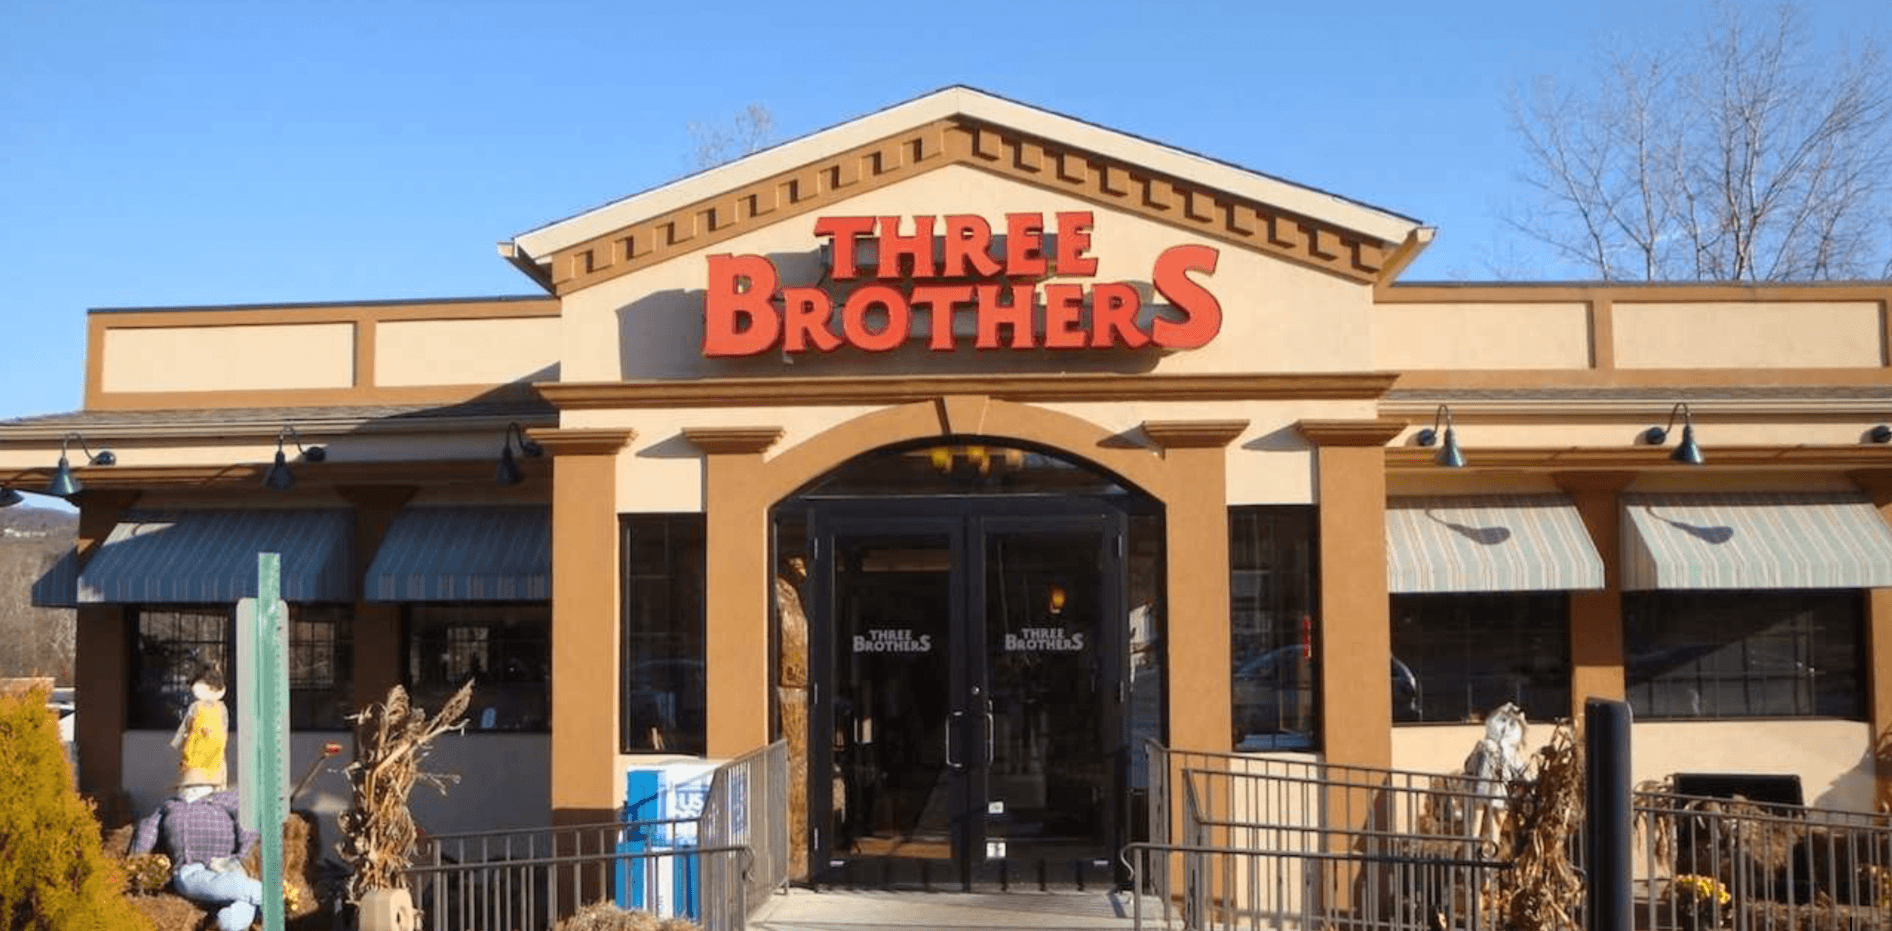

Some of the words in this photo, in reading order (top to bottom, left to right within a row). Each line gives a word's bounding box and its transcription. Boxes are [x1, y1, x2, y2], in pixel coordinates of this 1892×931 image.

[813, 211, 1100, 281] THREE
[703, 243, 1223, 358] BROTHERS
[869, 629, 913, 640] THREE
[1005, 632, 1084, 651] BROTHERS
[1021, 627, 1065, 639] THREE
[853, 634, 931, 652] BROTHERS
